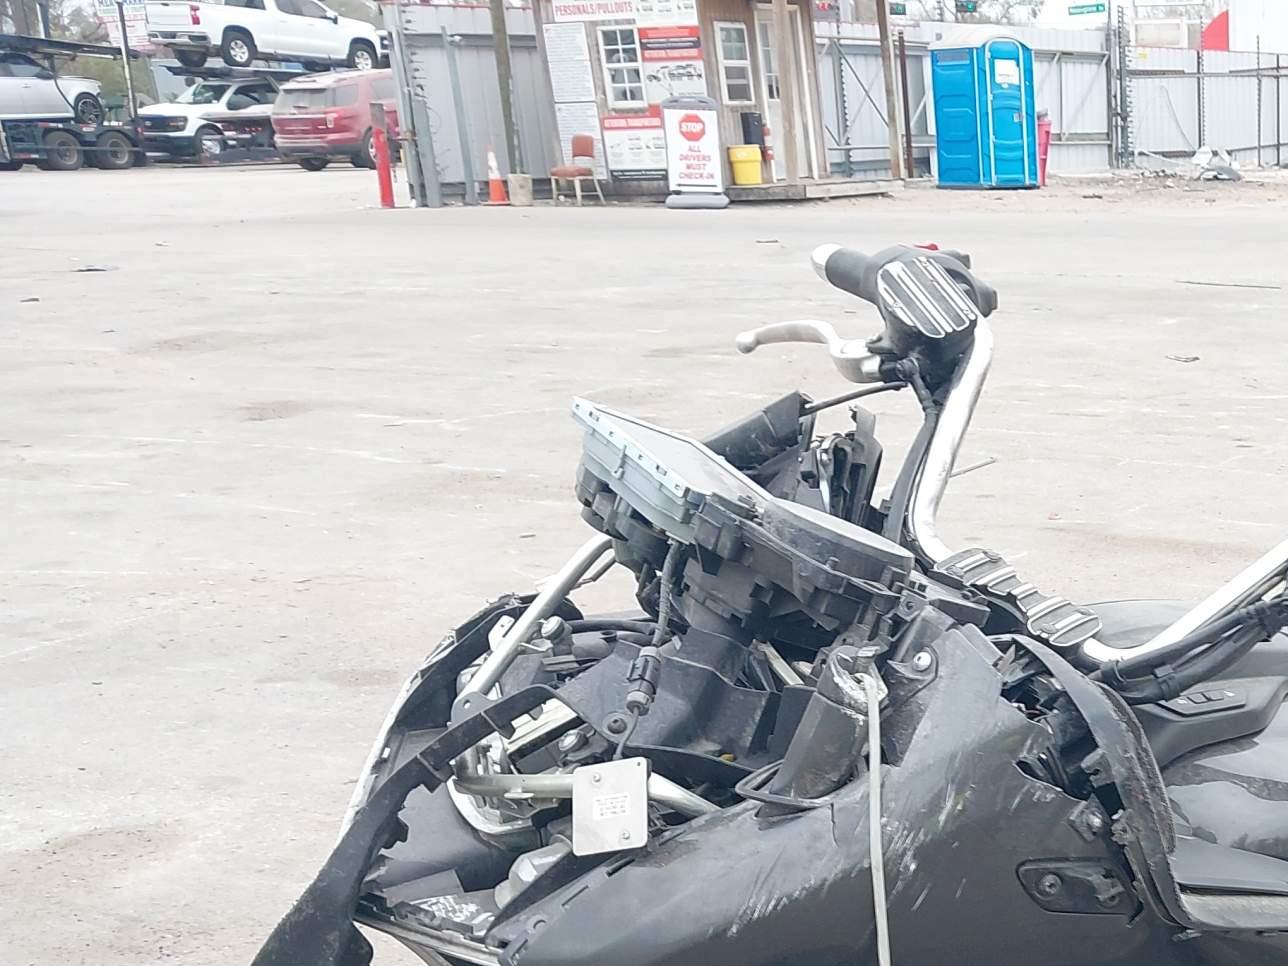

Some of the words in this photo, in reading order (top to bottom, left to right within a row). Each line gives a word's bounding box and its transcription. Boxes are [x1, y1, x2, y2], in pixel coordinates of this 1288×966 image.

[555, 2, 633, 17] PERSONALS/PULLOUTS
[680, 122, 704, 132] STOP
[679, 154, 711, 162] DRIVERS
[685, 163, 706, 171] MUST
[678, 171, 714, 180] CHECK-IN
